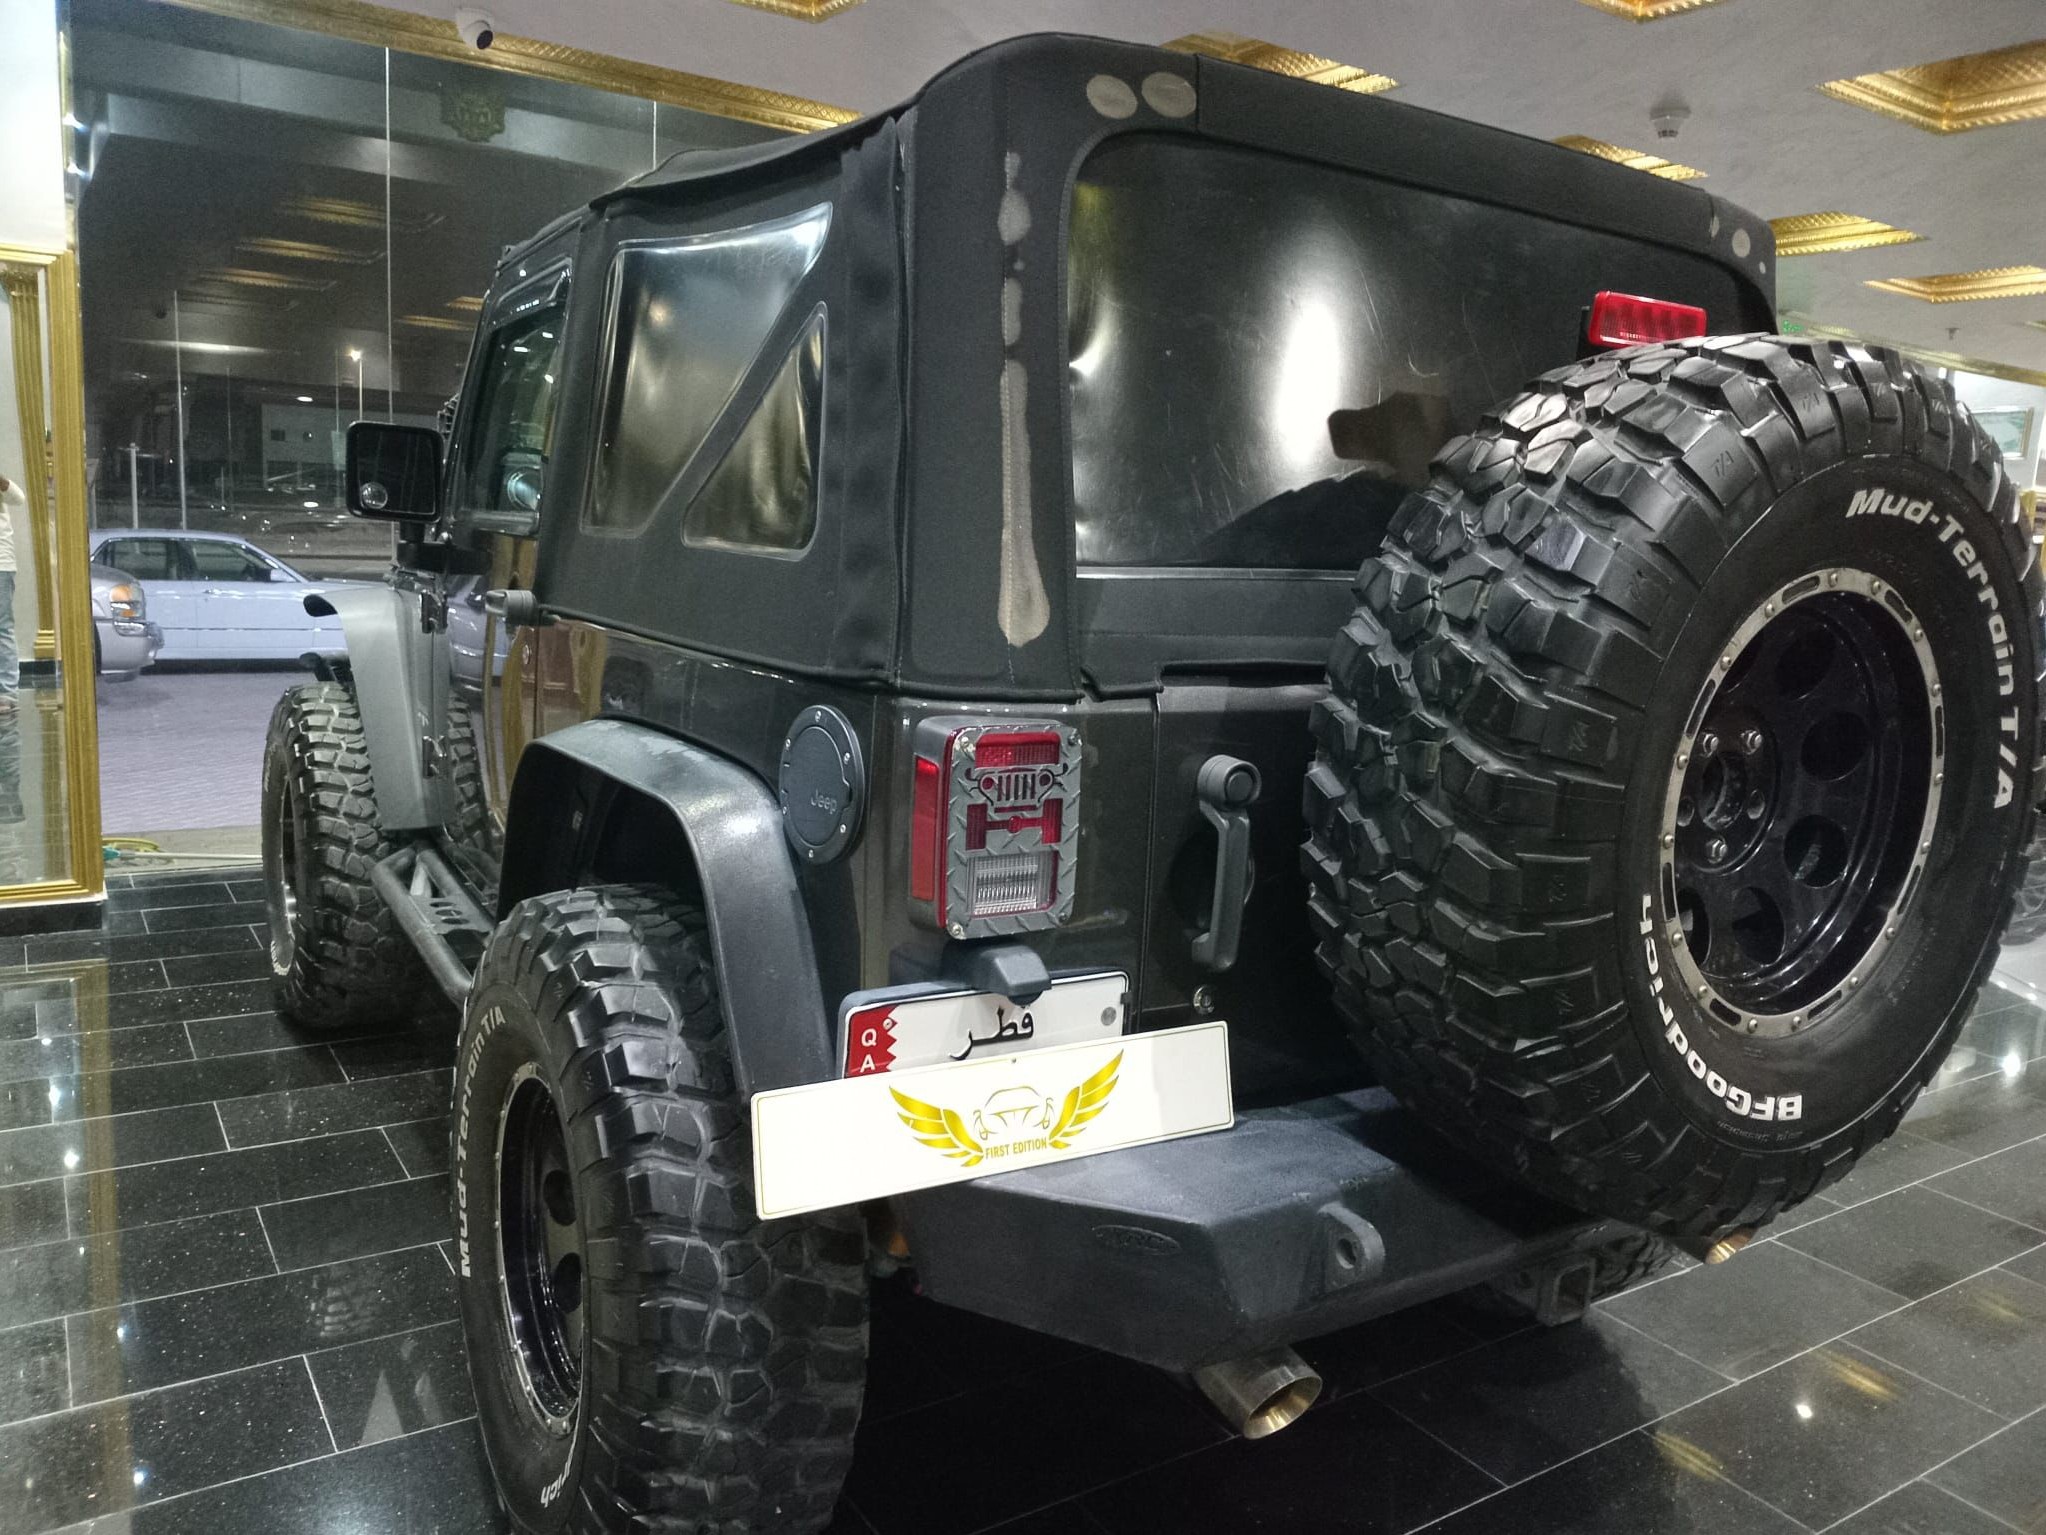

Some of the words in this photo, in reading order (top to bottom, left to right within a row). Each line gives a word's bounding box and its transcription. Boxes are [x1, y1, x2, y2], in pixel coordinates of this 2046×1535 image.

[1846, 488, 2015, 696] Mud-Terrain
[1994, 706, 2018, 809] T/A
[811, 789, 837, 814] Jeep
[949, 1005, 1034, 1060] قطر
[1640, 894, 1802, 1120] BFGoodrich
[457, 1032, 485, 1279] Mud-Terrain
[481, 1006, 506, 1036] T/A
[985, 1144, 1010, 1159] FIRST
[1013, 1137, 1047, 1154] EDITION
